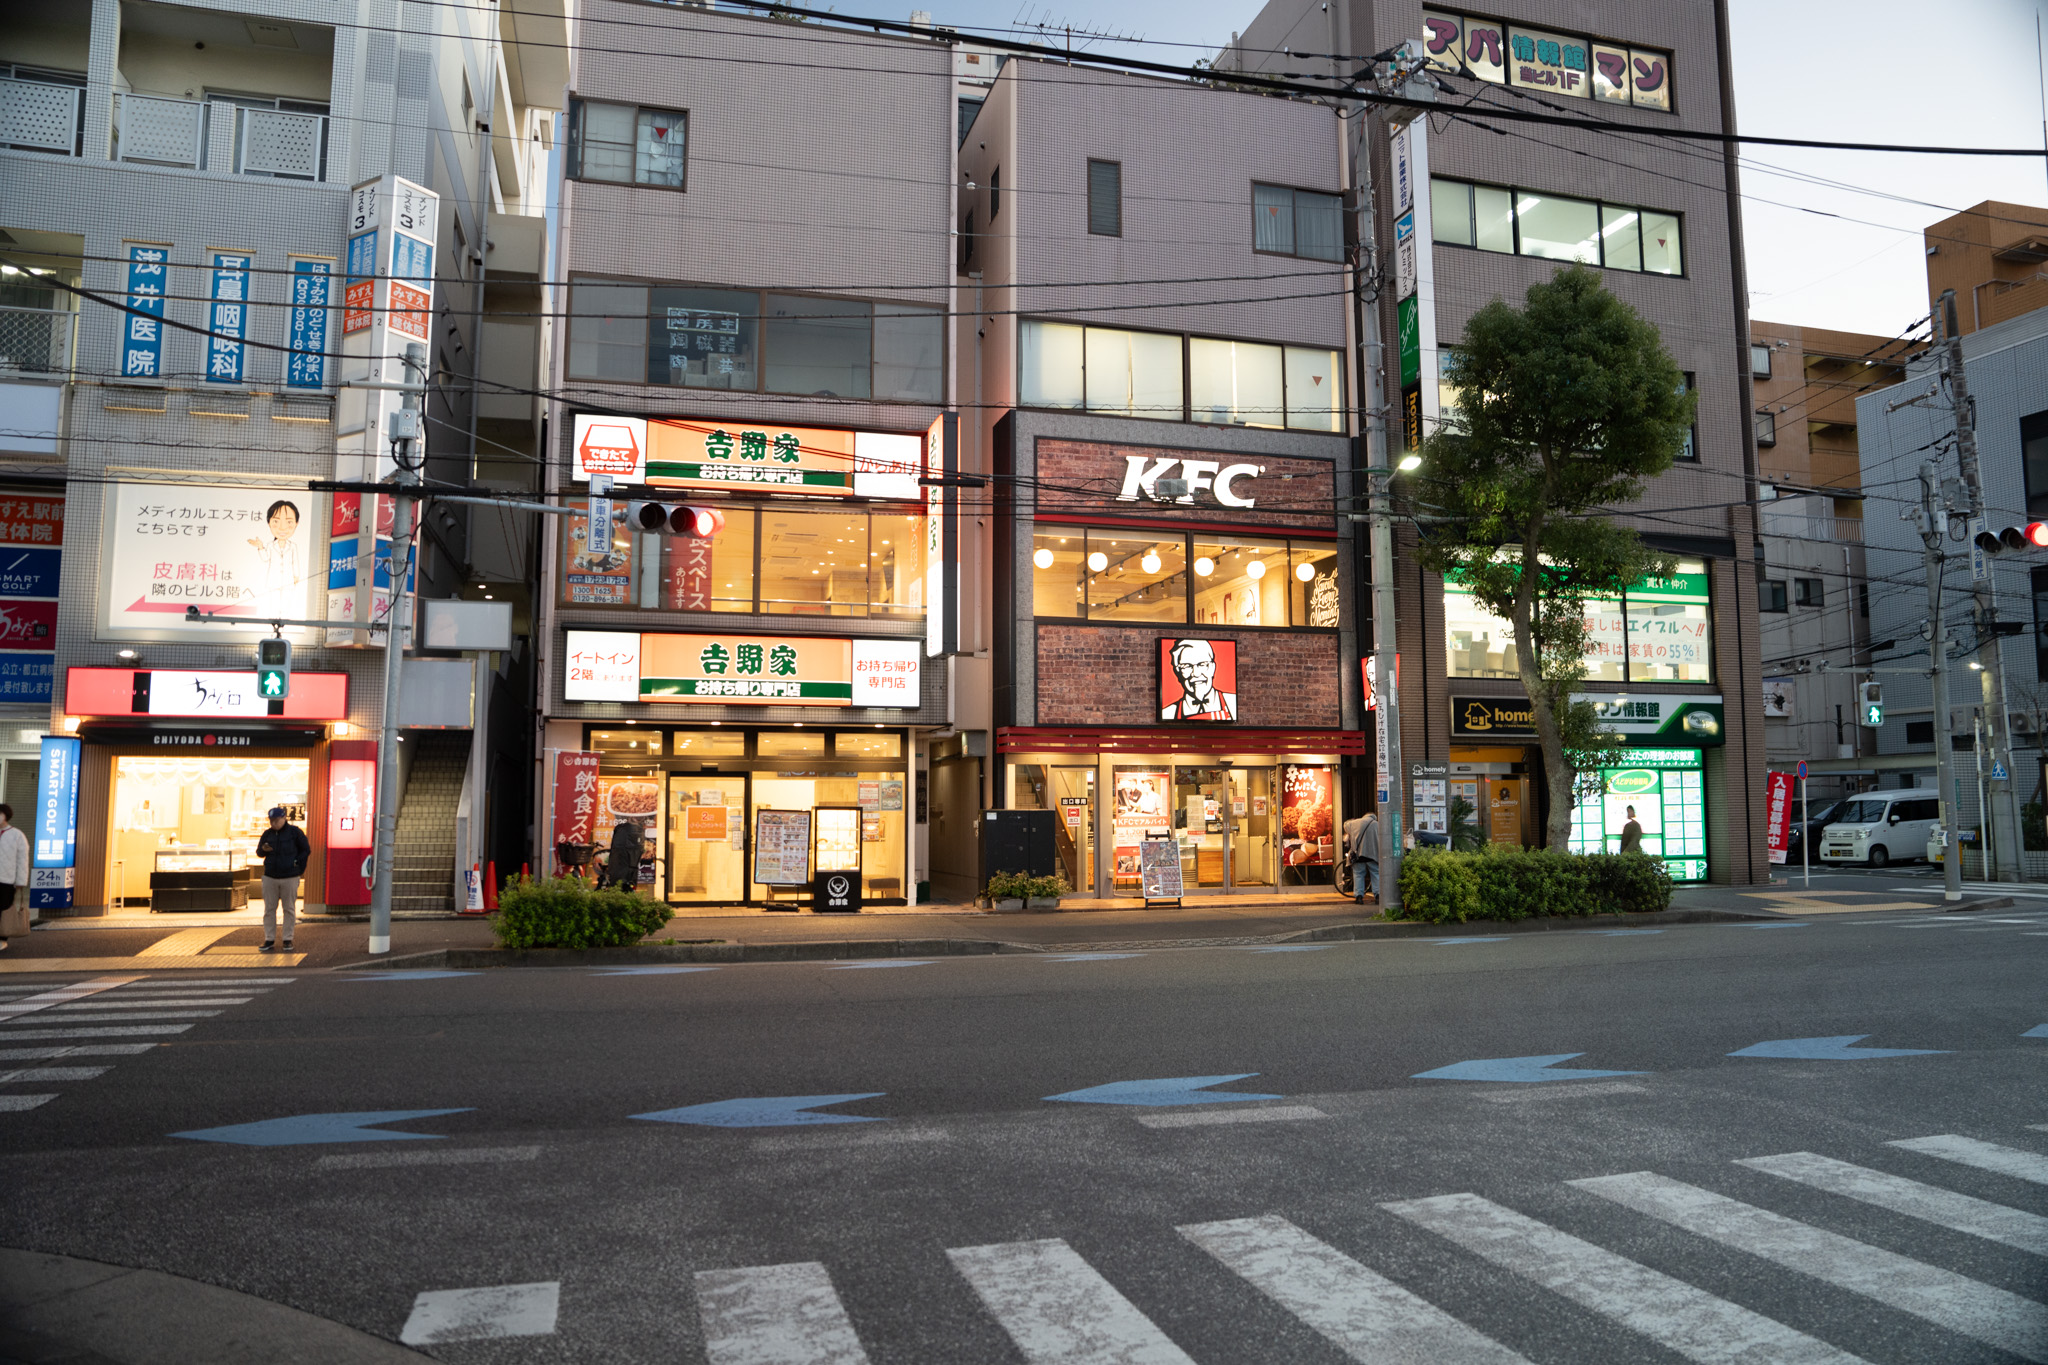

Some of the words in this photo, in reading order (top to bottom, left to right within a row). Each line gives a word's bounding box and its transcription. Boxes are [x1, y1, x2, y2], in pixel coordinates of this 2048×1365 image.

[1426, 17, 1502, 67] アパ
[1511, 34, 1587, 71] 情報館
[1595, 51, 1664, 92] マン
[1519, 66, 1580, 89] 当ビル1F
[354, 215, 366, 230] 3
[400, 214, 413, 230] 3
[380, 267, 386, 275] 3
[348, 286, 372, 301] みずえ
[393, 286, 426, 308] みずえ
[128, 250, 162, 376] 浅井医院
[211, 256, 245, 380] 耳鼻咽喉科
[346, 314, 371, 331] 整体院
[392, 317, 425, 337] 整体院
[374, 369, 379, 377] 2
[589, 448, 629, 460] できたて
[706, 430, 800, 464] 吉野家
[1116, 456, 1260, 508] KFC
[137, 505, 263, 522] メディカルエステは
[136, 522, 208, 537] こちらです
[1974, 534, 1984, 578] 分離式
[153, 562, 233, 582] 皮膚科は
[2, 582, 33, 590] GOLF
[151, 583, 256, 599] 隣のビル3階へ
[675, 566, 686, 609] あります
[1541, 617, 1706, 637] 探しはエイブルへ!!
[571, 651, 634, 665] イートイン
[699, 642, 797, 675] 吉野家
[856, 659, 918, 673] お持ち帰り
[694, 680, 801, 698] お持ち帰り専門店
[868, 676, 906, 689] 専門店
[1494, 707, 1535, 722] home
[1574, 702, 1660, 718] マン情報館
[154, 735, 202, 745] CHIYODA
[217, 736, 251, 746] SUSHI
[1423, 766, 1447, 774] homely
[569, 770, 597, 843] 飲食スペ
[1768, 776, 1786, 847] 入居者募集中
[36, 870, 61, 881] 24h
